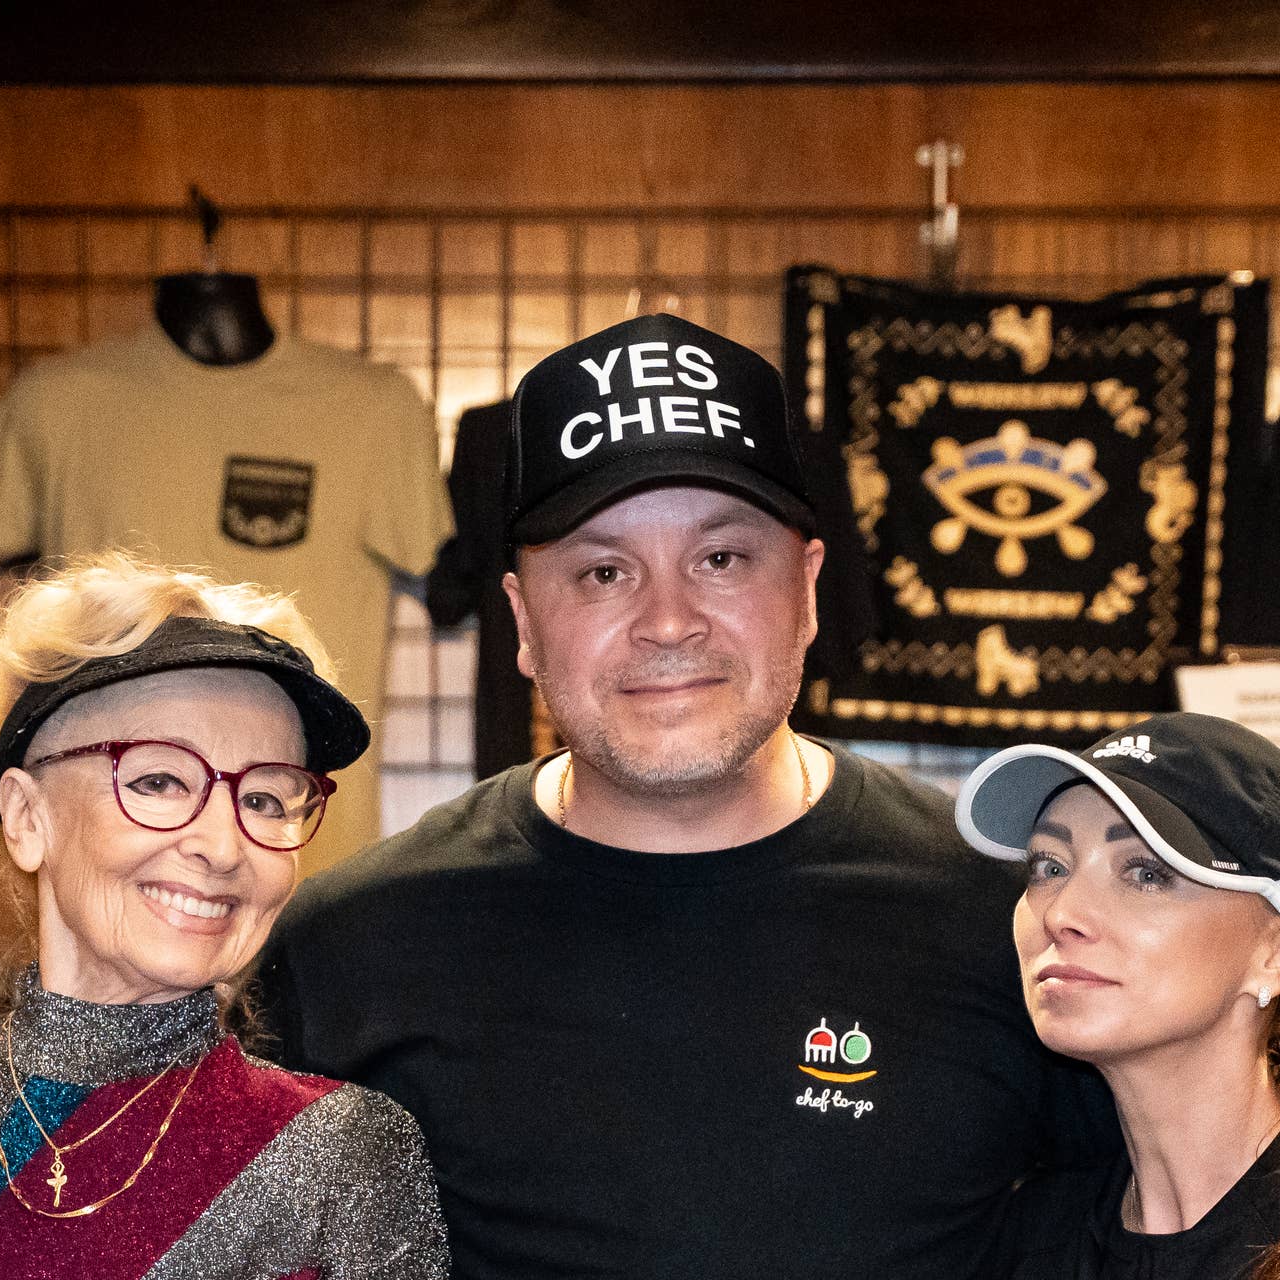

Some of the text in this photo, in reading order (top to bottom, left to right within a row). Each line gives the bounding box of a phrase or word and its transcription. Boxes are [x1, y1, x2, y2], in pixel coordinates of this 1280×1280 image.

[579, 341, 718, 396] YES
[560, 395, 755, 459] CHEF.
[796, 1087, 831, 1112] chef
